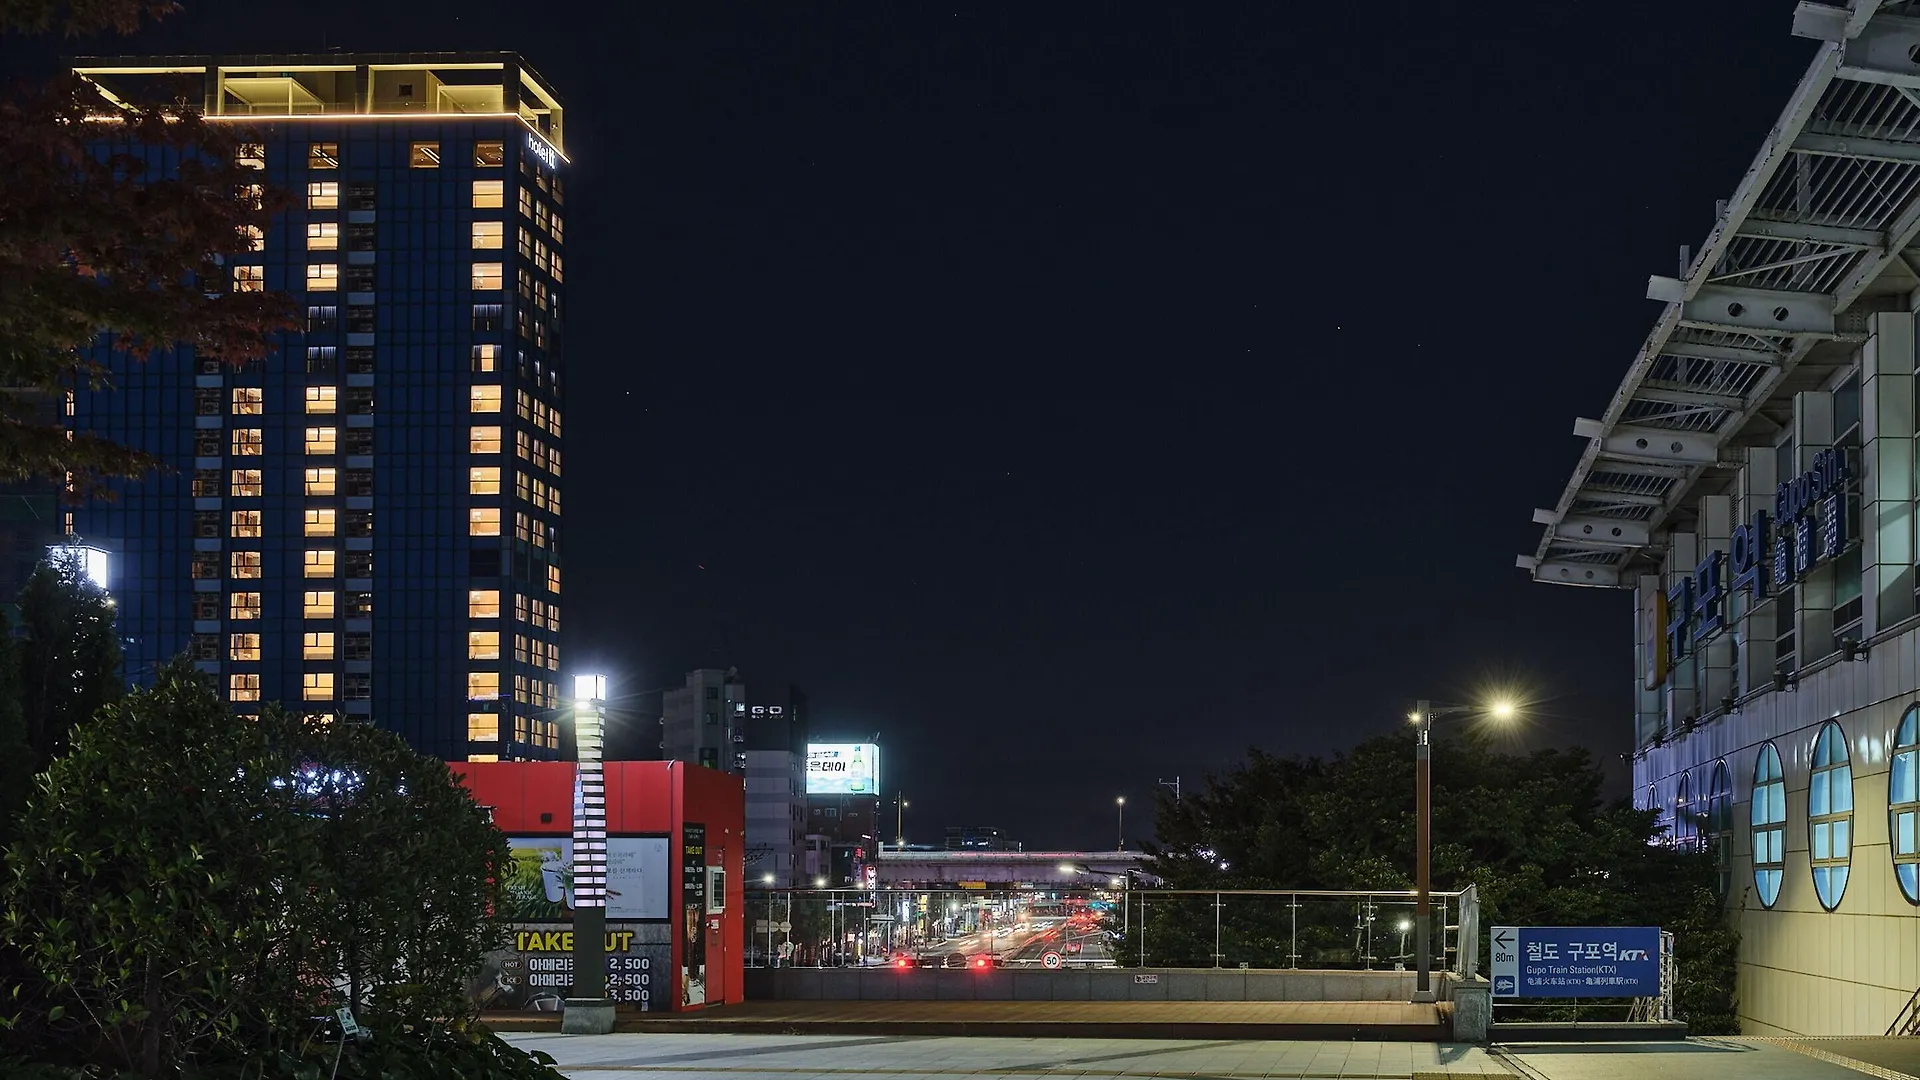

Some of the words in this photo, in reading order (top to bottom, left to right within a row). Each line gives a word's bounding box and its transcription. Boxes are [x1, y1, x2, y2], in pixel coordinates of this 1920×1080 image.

[1775, 471, 1810, 529] Gupo
[1667, 510, 1768, 660] 구포역
[805, 761, 846, 772] 은데이
[514, 932, 574, 951] TAKE
[604, 932, 634, 951] UT
[1495, 952, 1514, 962] 80m
[1526, 942, 1560, 962] 철도
[1567, 942, 1617, 962] 구포역
[1619, 949, 1650, 961] KTX
[1046, 956, 1057, 965] 50
[1526, 965, 1547, 976] Gupo
[1548, 965, 1568, 974] Train
[1569, 965, 1617, 975] Station(KTX)
